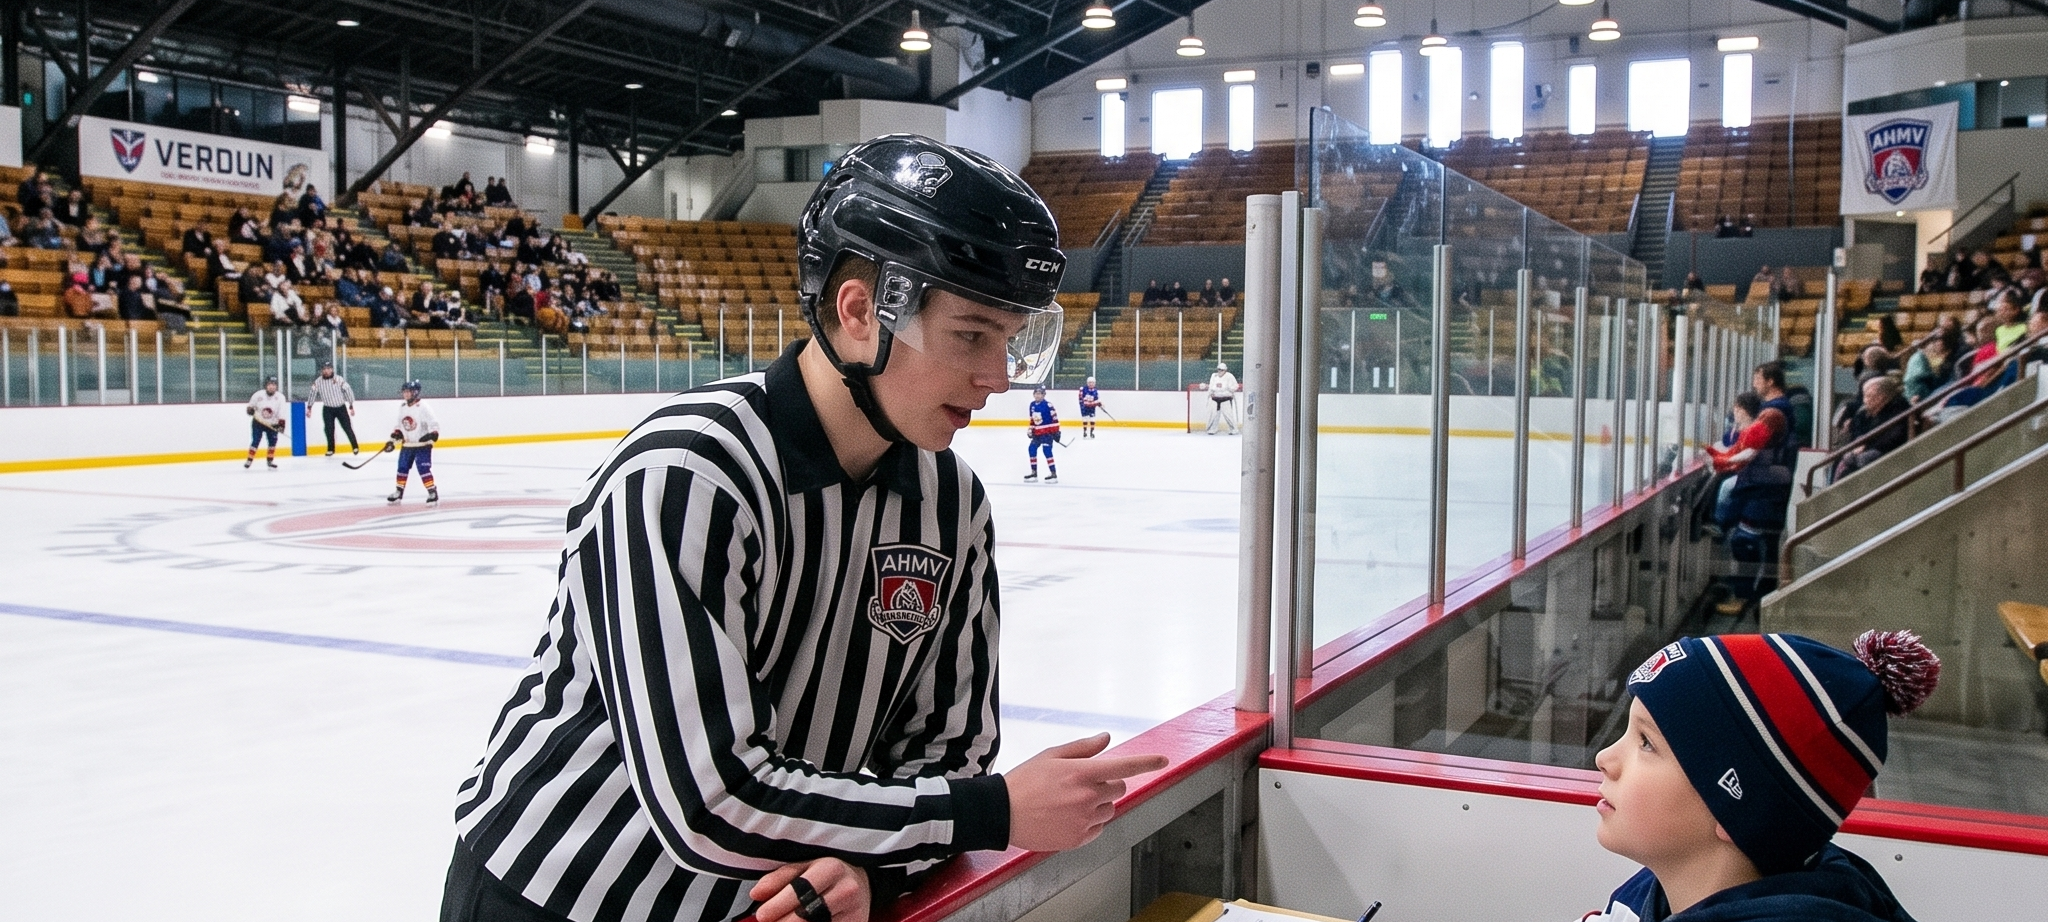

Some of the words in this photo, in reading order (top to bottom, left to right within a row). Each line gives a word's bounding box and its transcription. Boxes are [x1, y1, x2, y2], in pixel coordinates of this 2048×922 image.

[1873, 127, 1924, 149] AHMV
[154, 138, 273, 180] VERDUN
[1025, 257, 1061, 273] CCM
[881, 553, 943, 577] AHMV
